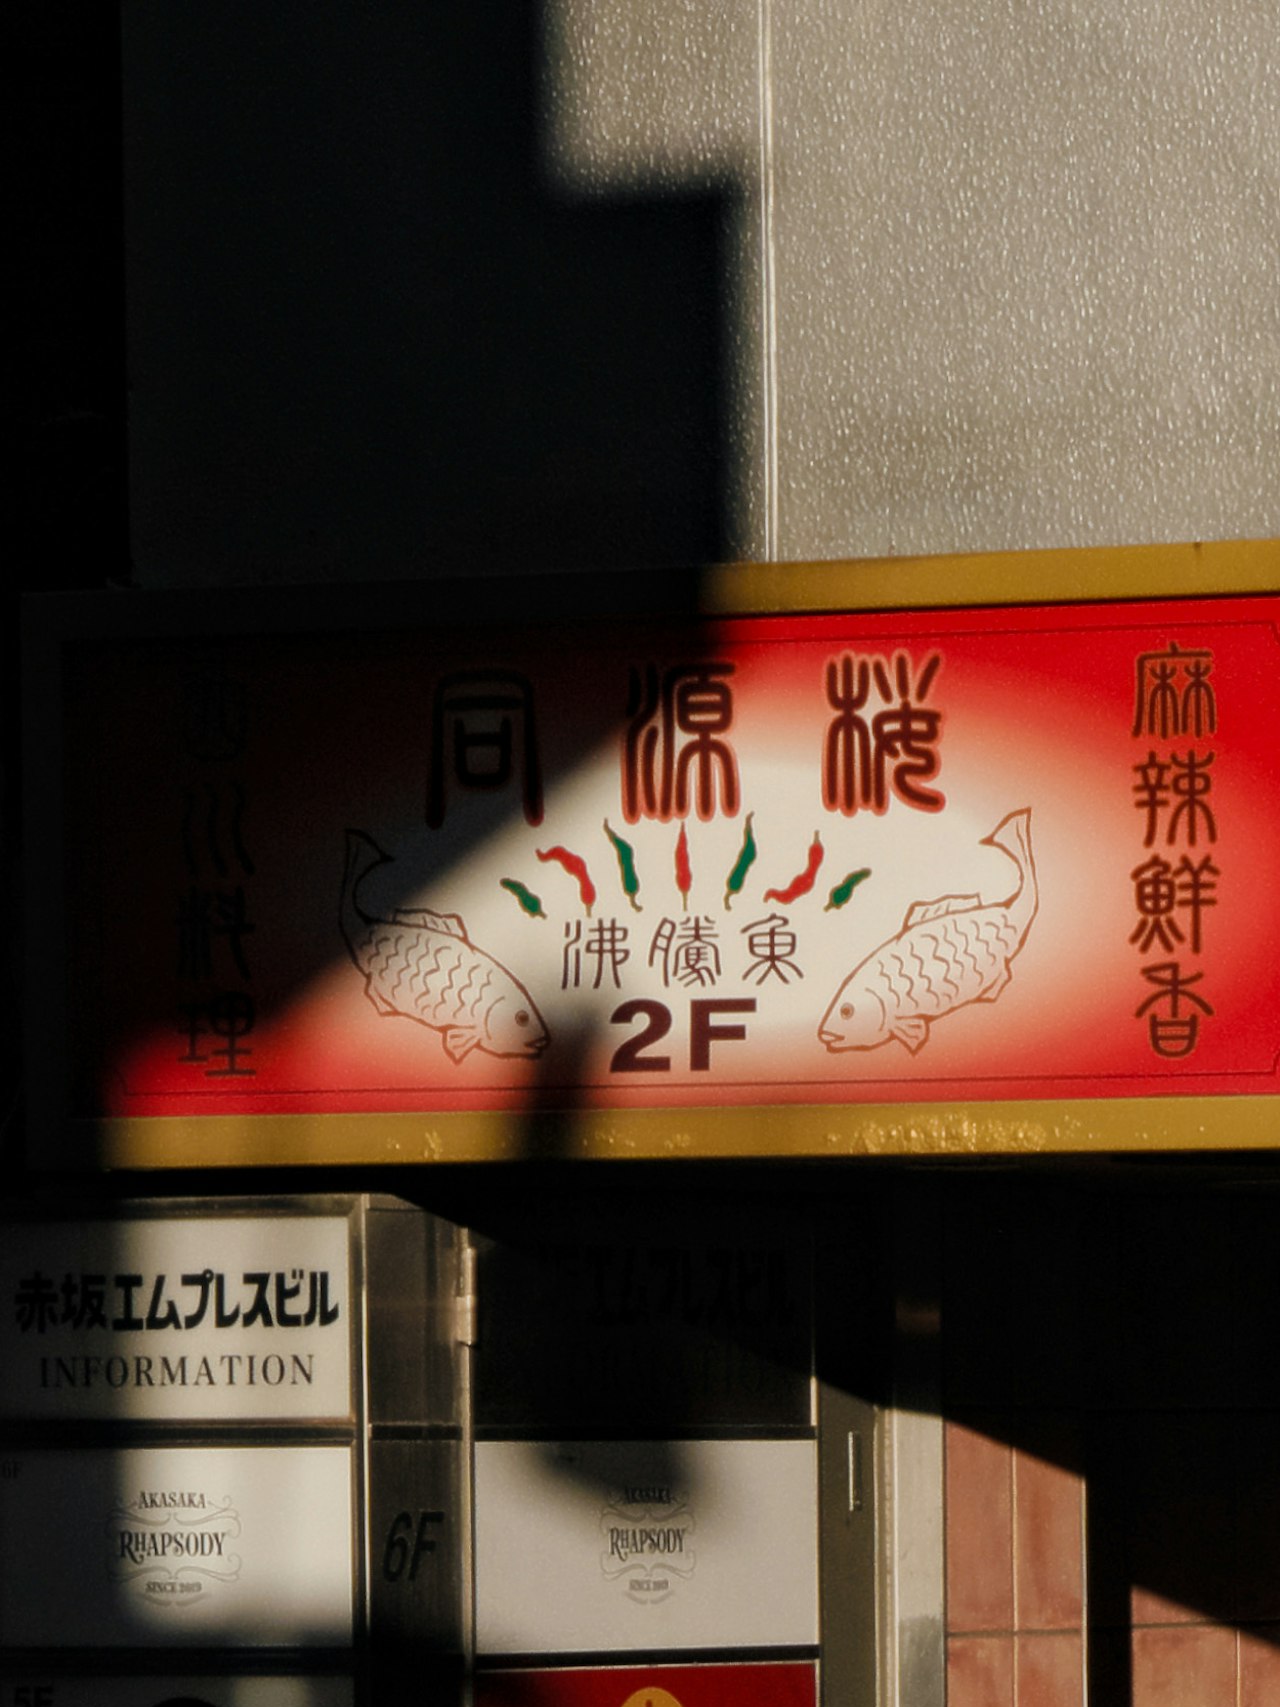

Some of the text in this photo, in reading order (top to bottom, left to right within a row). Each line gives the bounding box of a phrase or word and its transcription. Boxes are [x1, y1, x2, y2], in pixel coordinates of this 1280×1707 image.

[1129, 641, 1220, 1058] 麻辣鮮香
[608, 998, 757, 1074] 2F
[14, 1267, 340, 1333] 赤坂エムプレスビル
[40, 1353, 315, 1389] INFORMATION
[1, 1458, 24, 1480] 6F
[138, 1491, 207, 1509] AKASAKA
[119, 1530, 227, 1565] RHAPSODY
[381, 1510, 445, 1584] 6F
[609, 1527, 686, 1562] RHAPSODY
